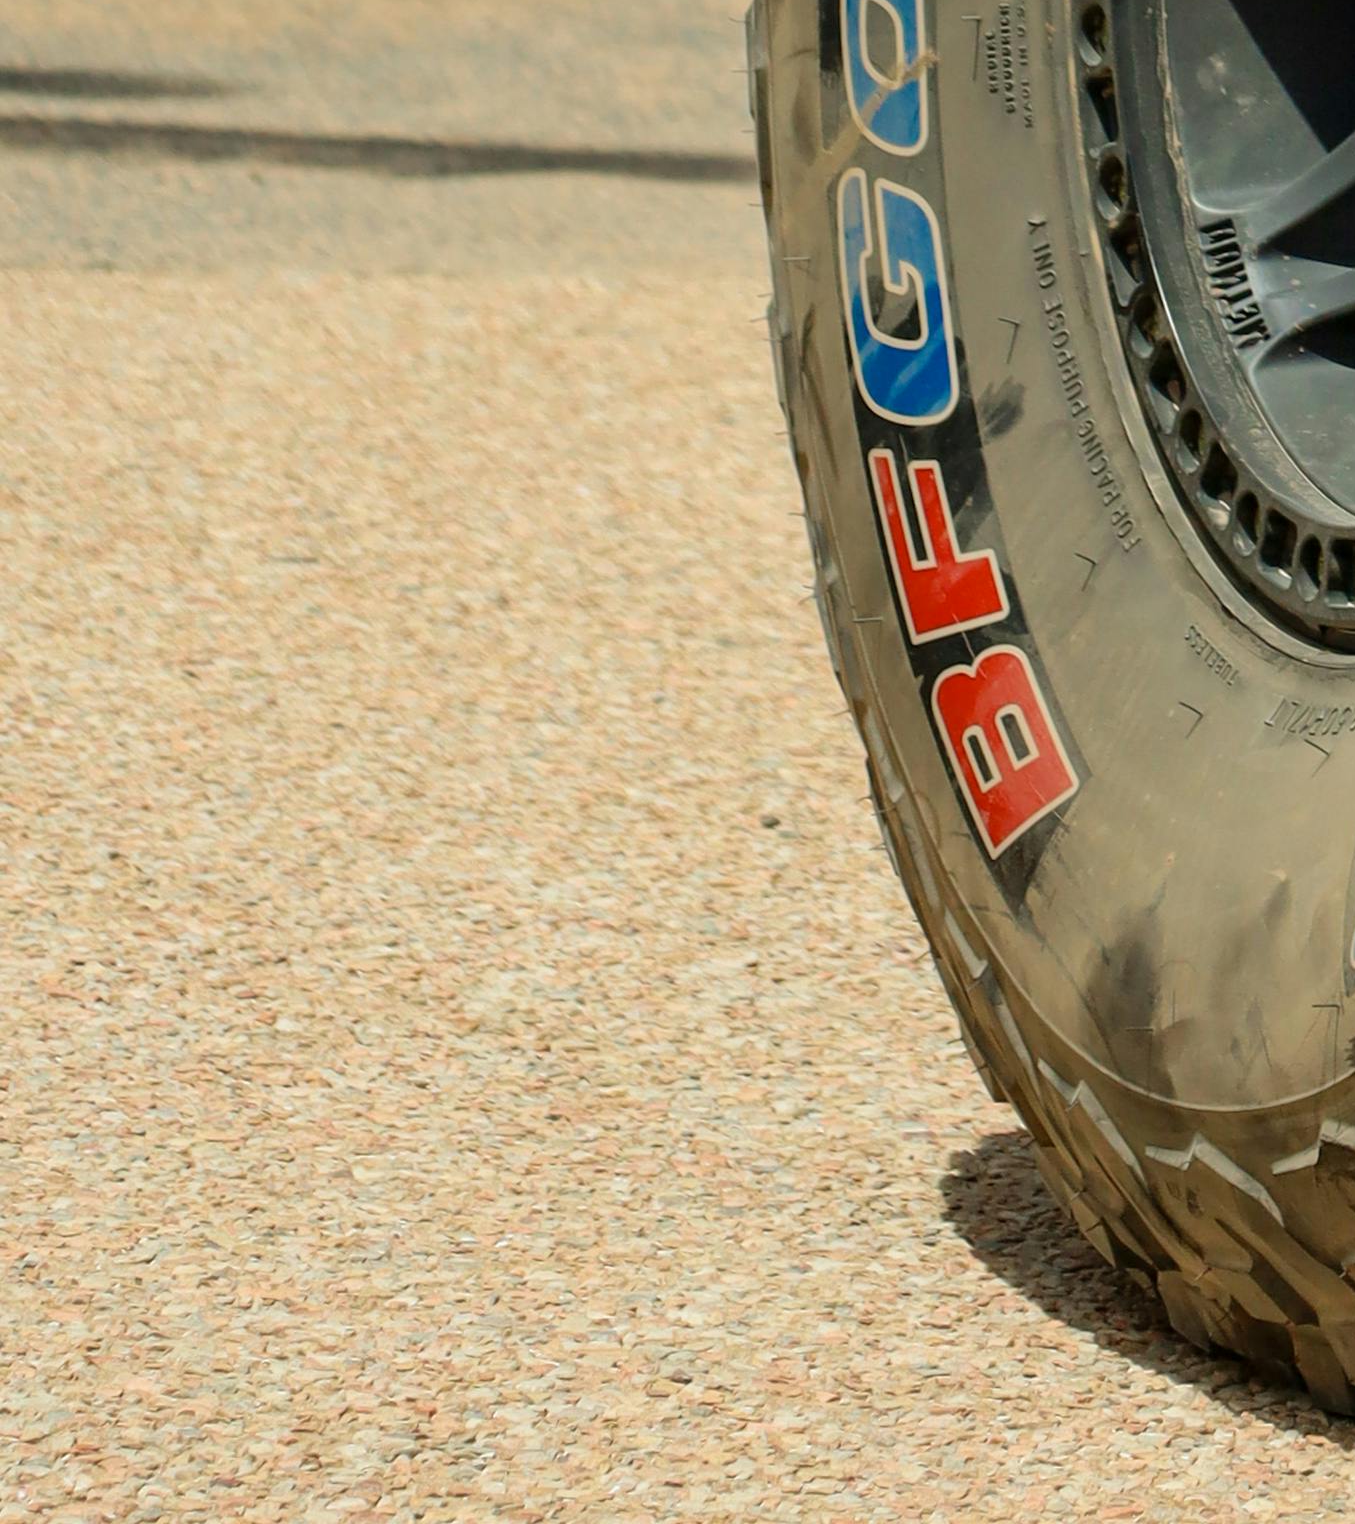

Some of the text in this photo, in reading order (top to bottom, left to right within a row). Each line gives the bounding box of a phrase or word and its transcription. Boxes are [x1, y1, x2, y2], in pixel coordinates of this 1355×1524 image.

[1041, 294, 1091, 419] PURPOSE
[1072, 417, 1123, 506] RACING
[1109, 505, 1142, 554] FOR
